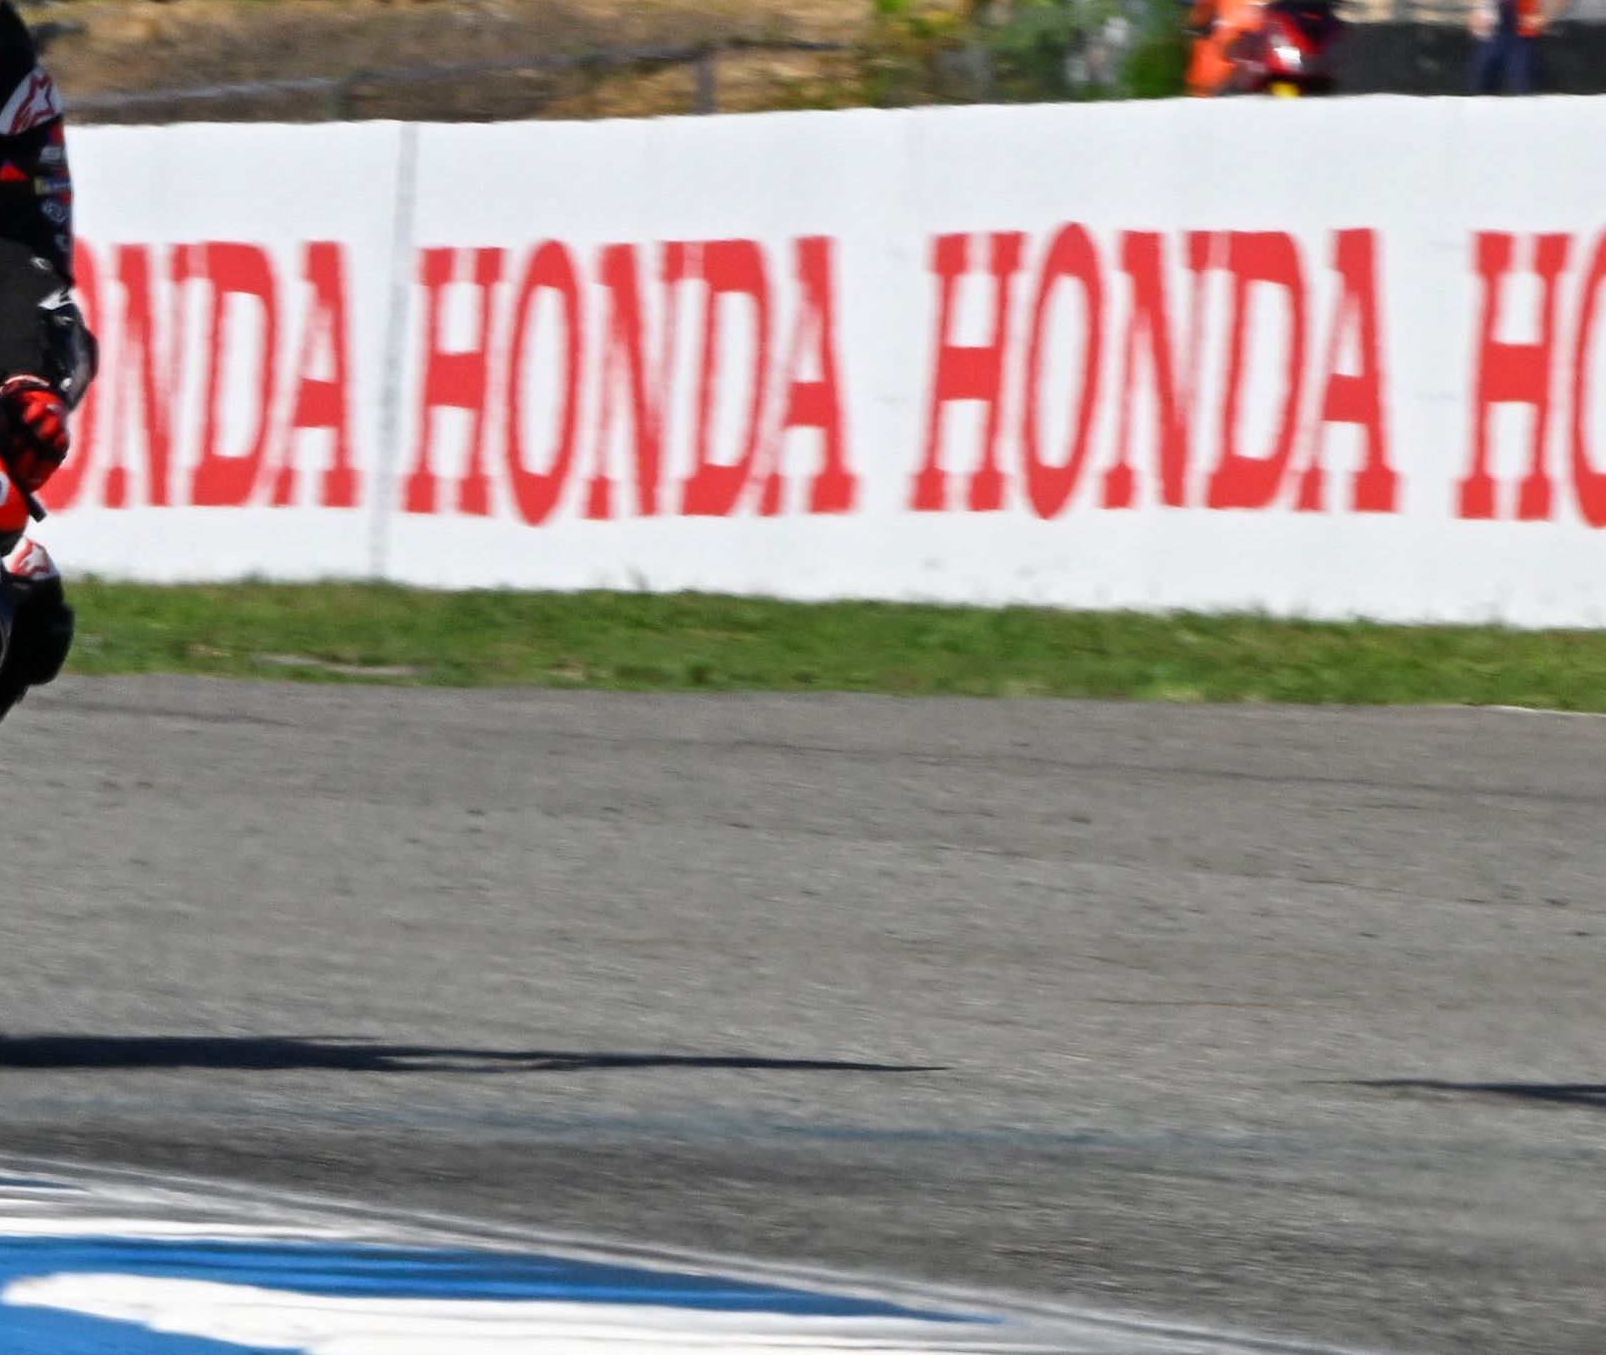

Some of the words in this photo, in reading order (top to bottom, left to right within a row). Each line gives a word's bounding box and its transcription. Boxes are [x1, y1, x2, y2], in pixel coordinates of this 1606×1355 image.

[35, 236, 366, 512] ONDA
[397, 238, 860, 526] HONDA
[906, 221, 1405, 520] HONDA
